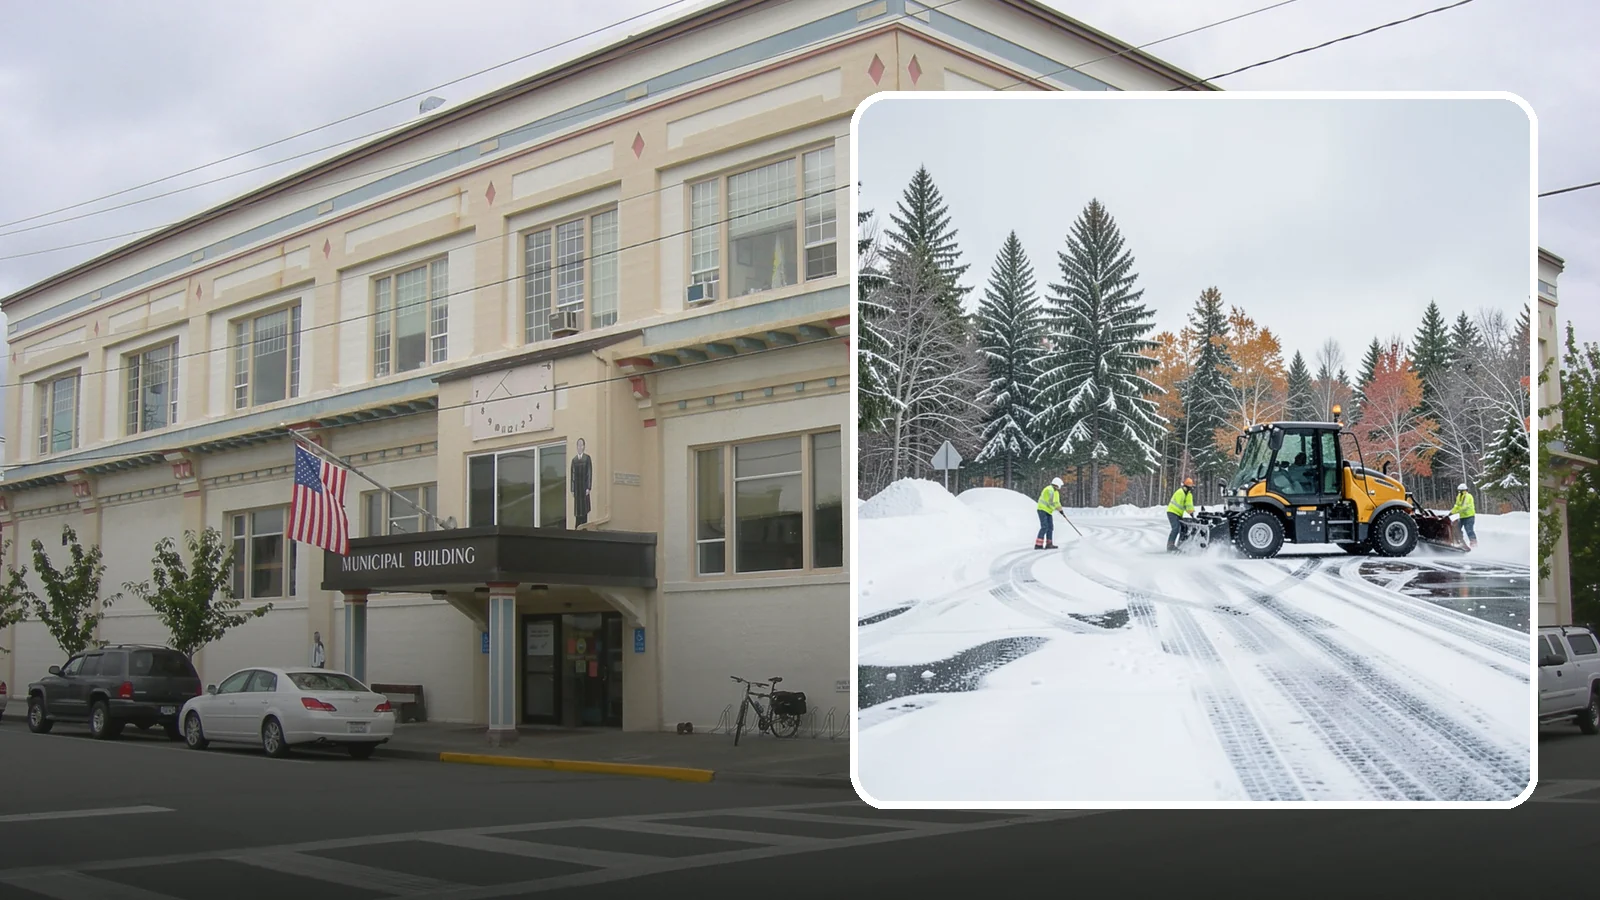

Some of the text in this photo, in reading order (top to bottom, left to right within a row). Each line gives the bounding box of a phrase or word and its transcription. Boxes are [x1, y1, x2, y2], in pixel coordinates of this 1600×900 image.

[547, 361, 552, 370] 6
[475, 390, 479, 398] 7
[536, 402, 540, 410] 4
[480, 407, 485, 415] 8
[487, 418, 492, 426] 9
[529, 414, 533, 422] 3
[494, 424, 500, 432] 10
[515, 424, 518, 432] 1
[521, 420, 526, 428] 2
[501, 426, 506, 434] 11
[507, 425, 513, 433] 12
[342, 546, 475, 572] MUNICIPAL BUILDING
